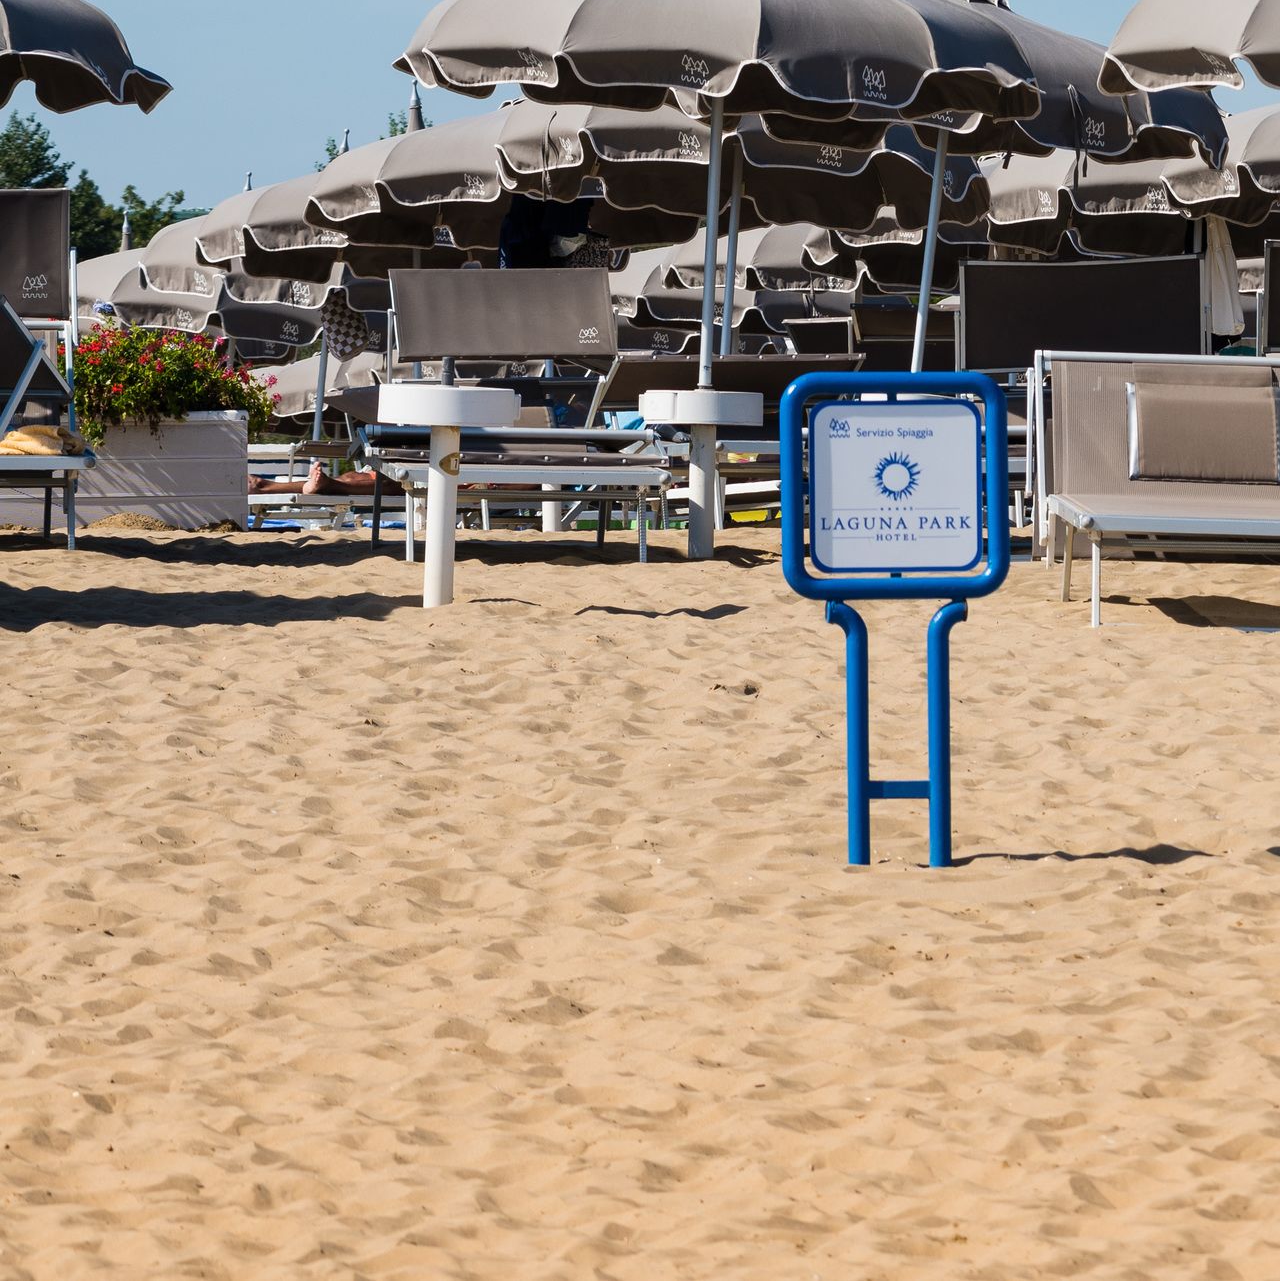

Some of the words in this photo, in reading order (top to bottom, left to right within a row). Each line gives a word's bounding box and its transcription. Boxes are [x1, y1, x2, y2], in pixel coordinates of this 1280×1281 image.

[856, 427, 894, 438] Servizio
[897, 427, 934, 439] Spiaggia
[820, 517, 908, 531] LAGUNA
[918, 515, 972, 530] PARK
[876, 533, 917, 542] HOTEL
